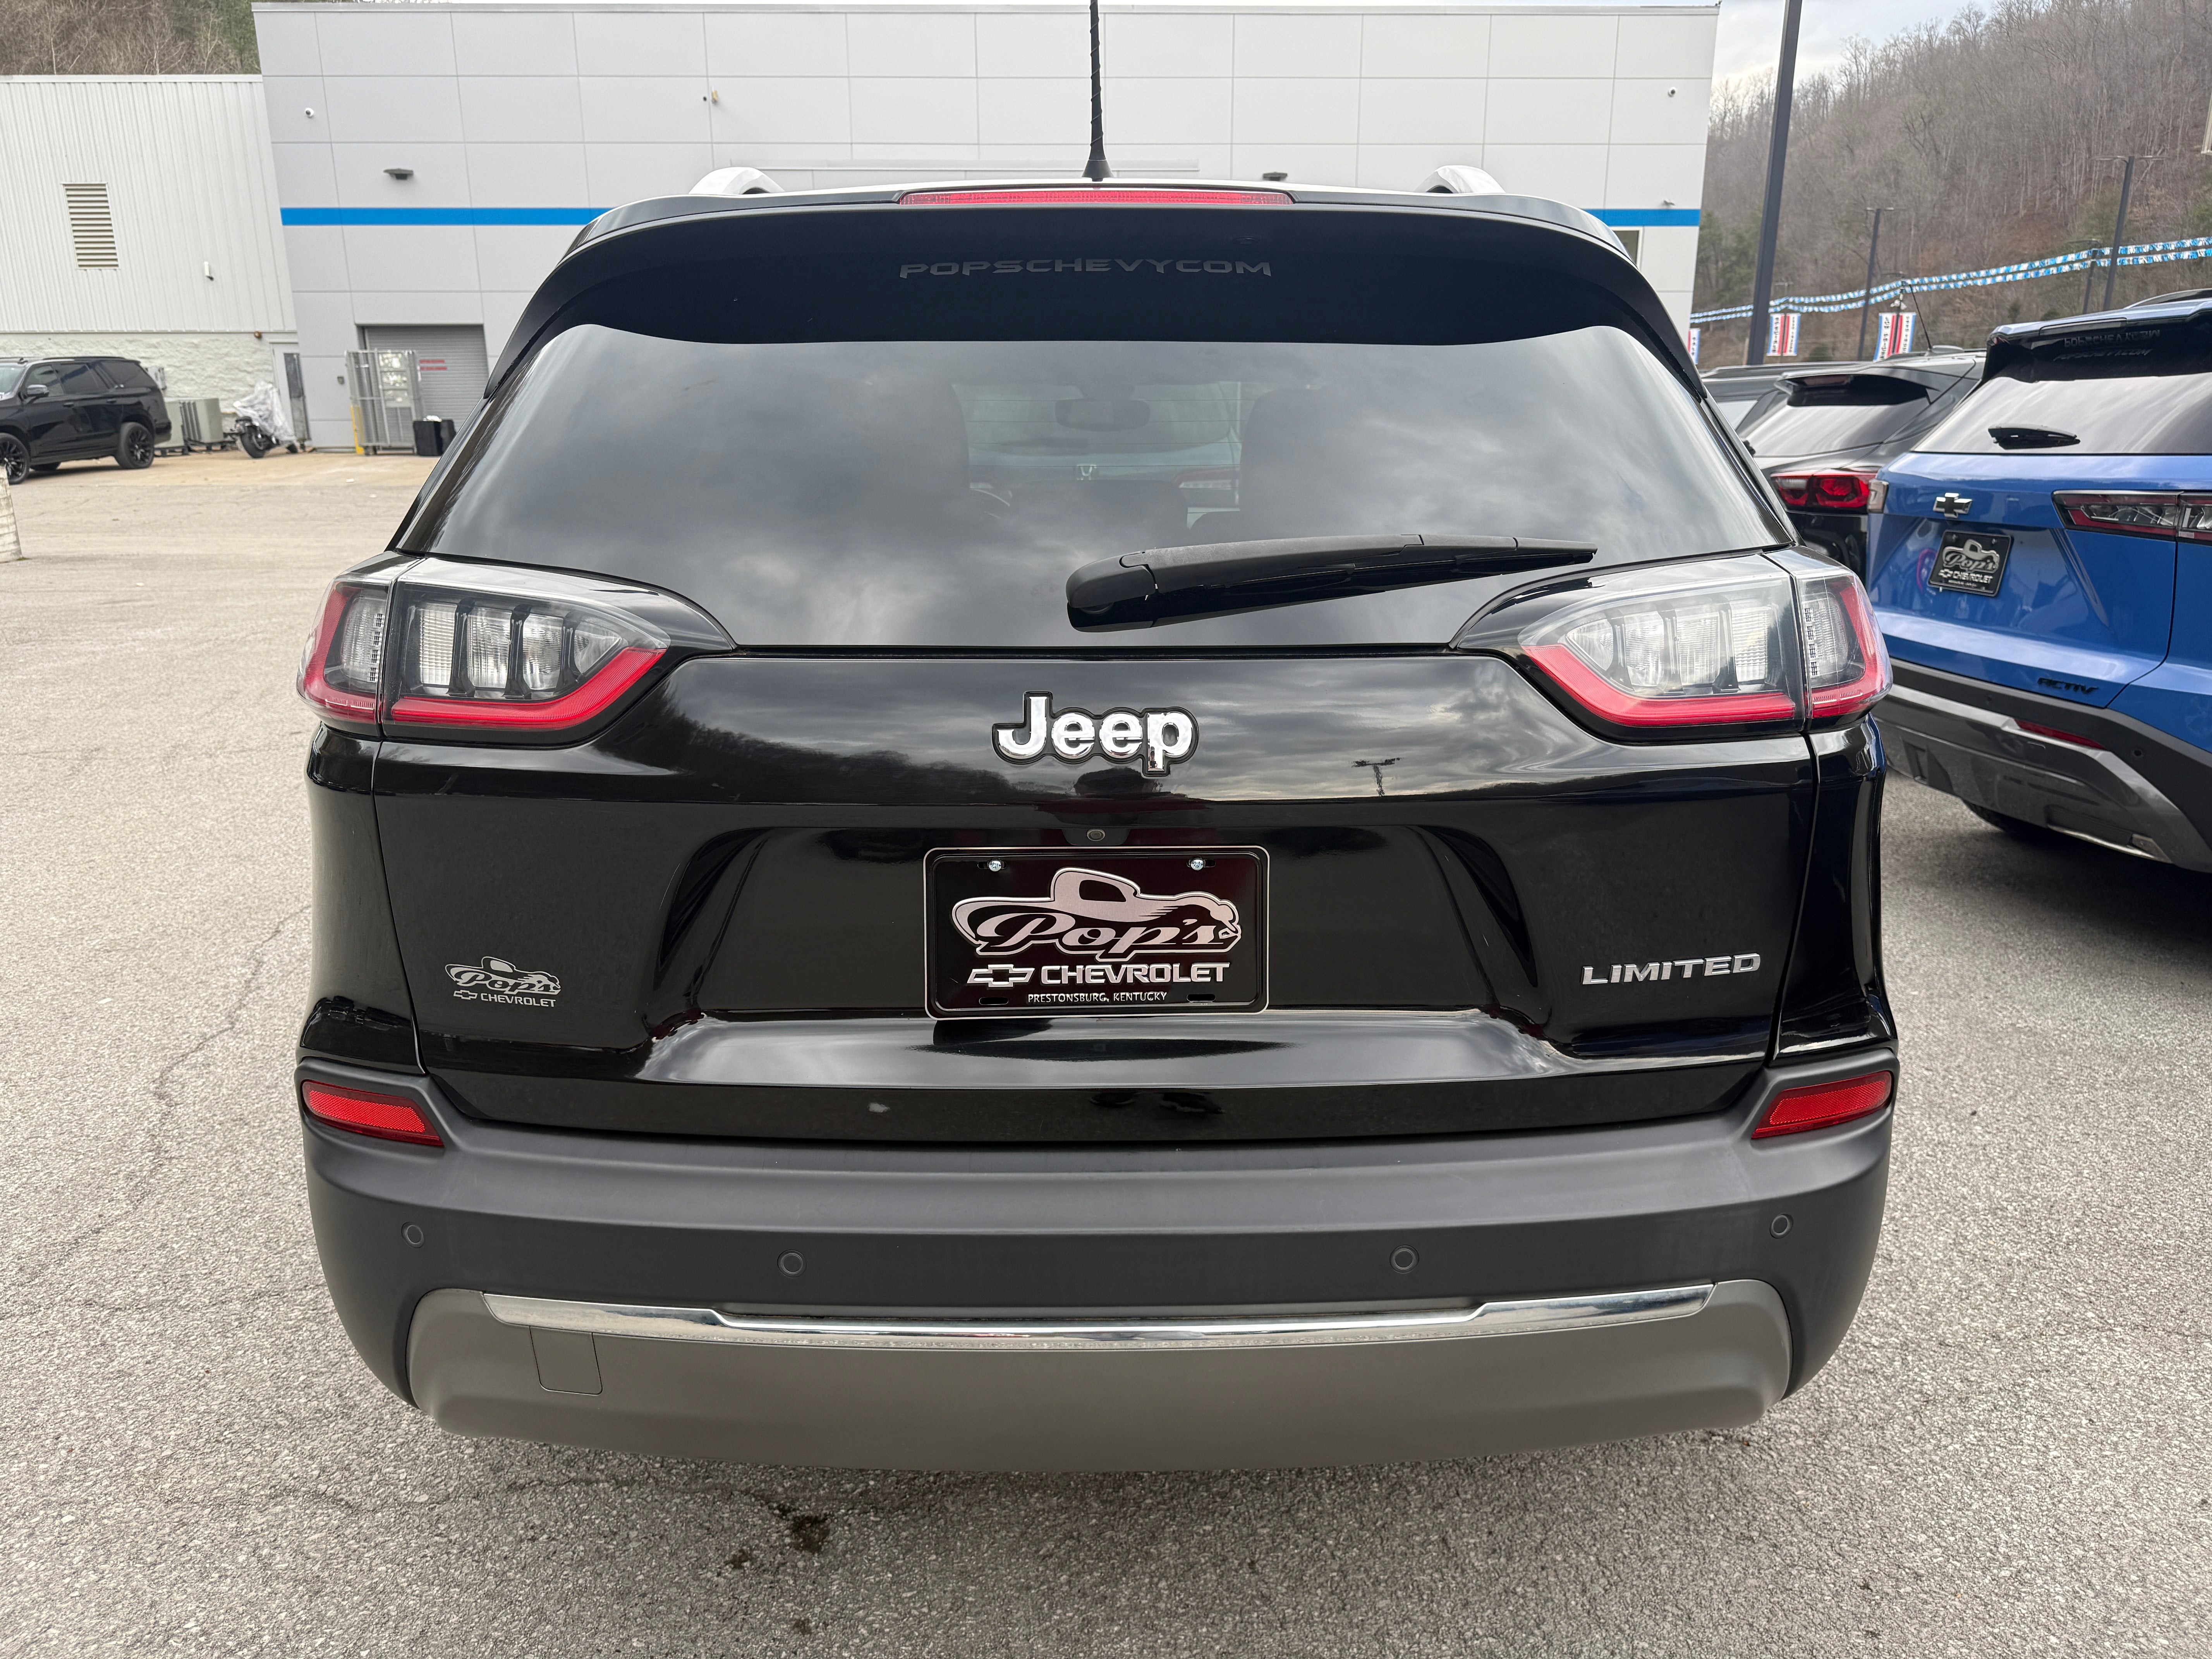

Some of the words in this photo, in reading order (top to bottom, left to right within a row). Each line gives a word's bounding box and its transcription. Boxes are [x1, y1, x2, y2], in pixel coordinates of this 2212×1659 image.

[996, 696, 1194, 772] Jeep
[977, 913, 1218, 954] Pop's
[1041, 962, 1230, 985] CHEVROLET
[1581, 953, 1761, 985] LIMITED
[481, 993, 556, 1007] CHEVROLET
[1028, 993, 1109, 1003] PRESTONSBURG,
[1113, 991, 1167, 1001] KENTUCKY
